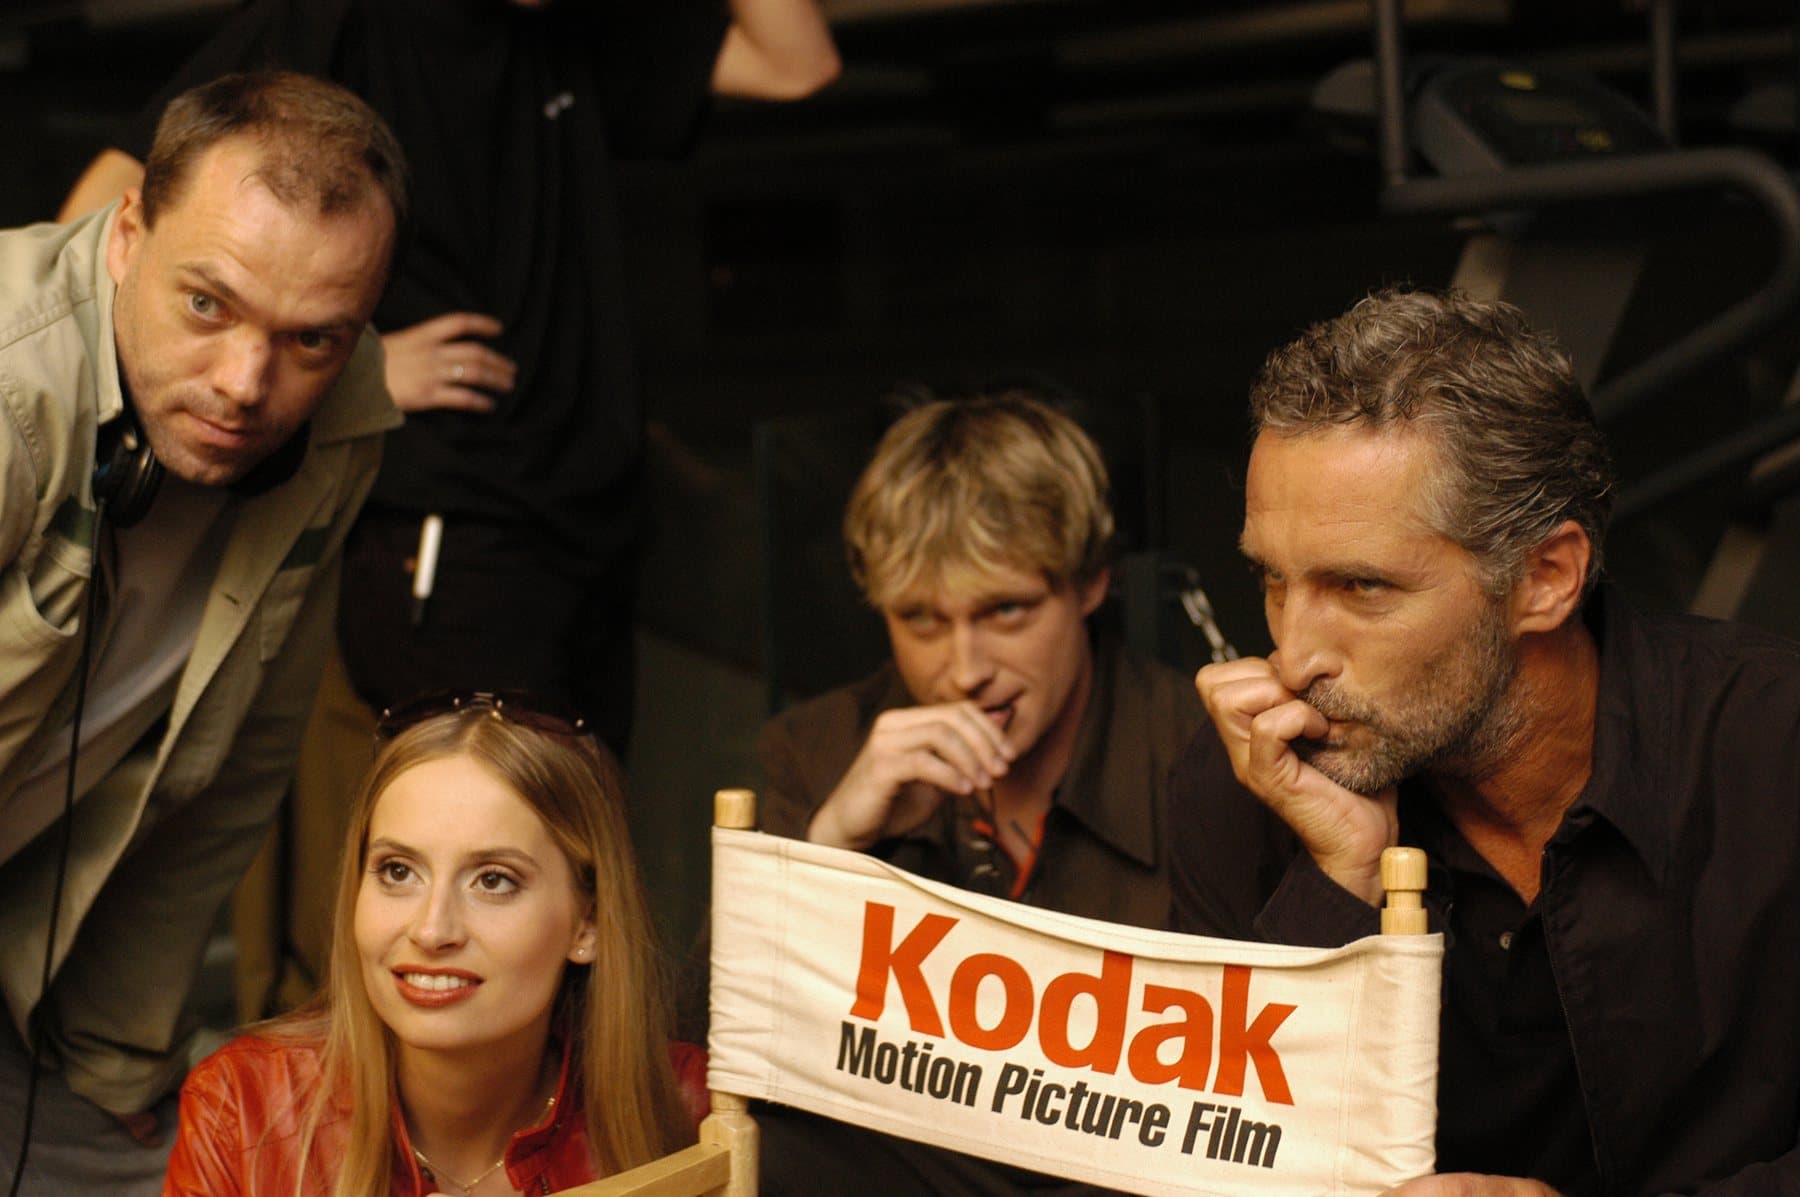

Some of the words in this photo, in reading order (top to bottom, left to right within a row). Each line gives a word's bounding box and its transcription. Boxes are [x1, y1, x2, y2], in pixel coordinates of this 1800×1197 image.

[849, 901, 1298, 1106] Kodak
[837, 1021, 982, 1107] Motion
[991, 1063, 1171, 1147] Picture
[1181, 1102, 1282, 1169] Film
